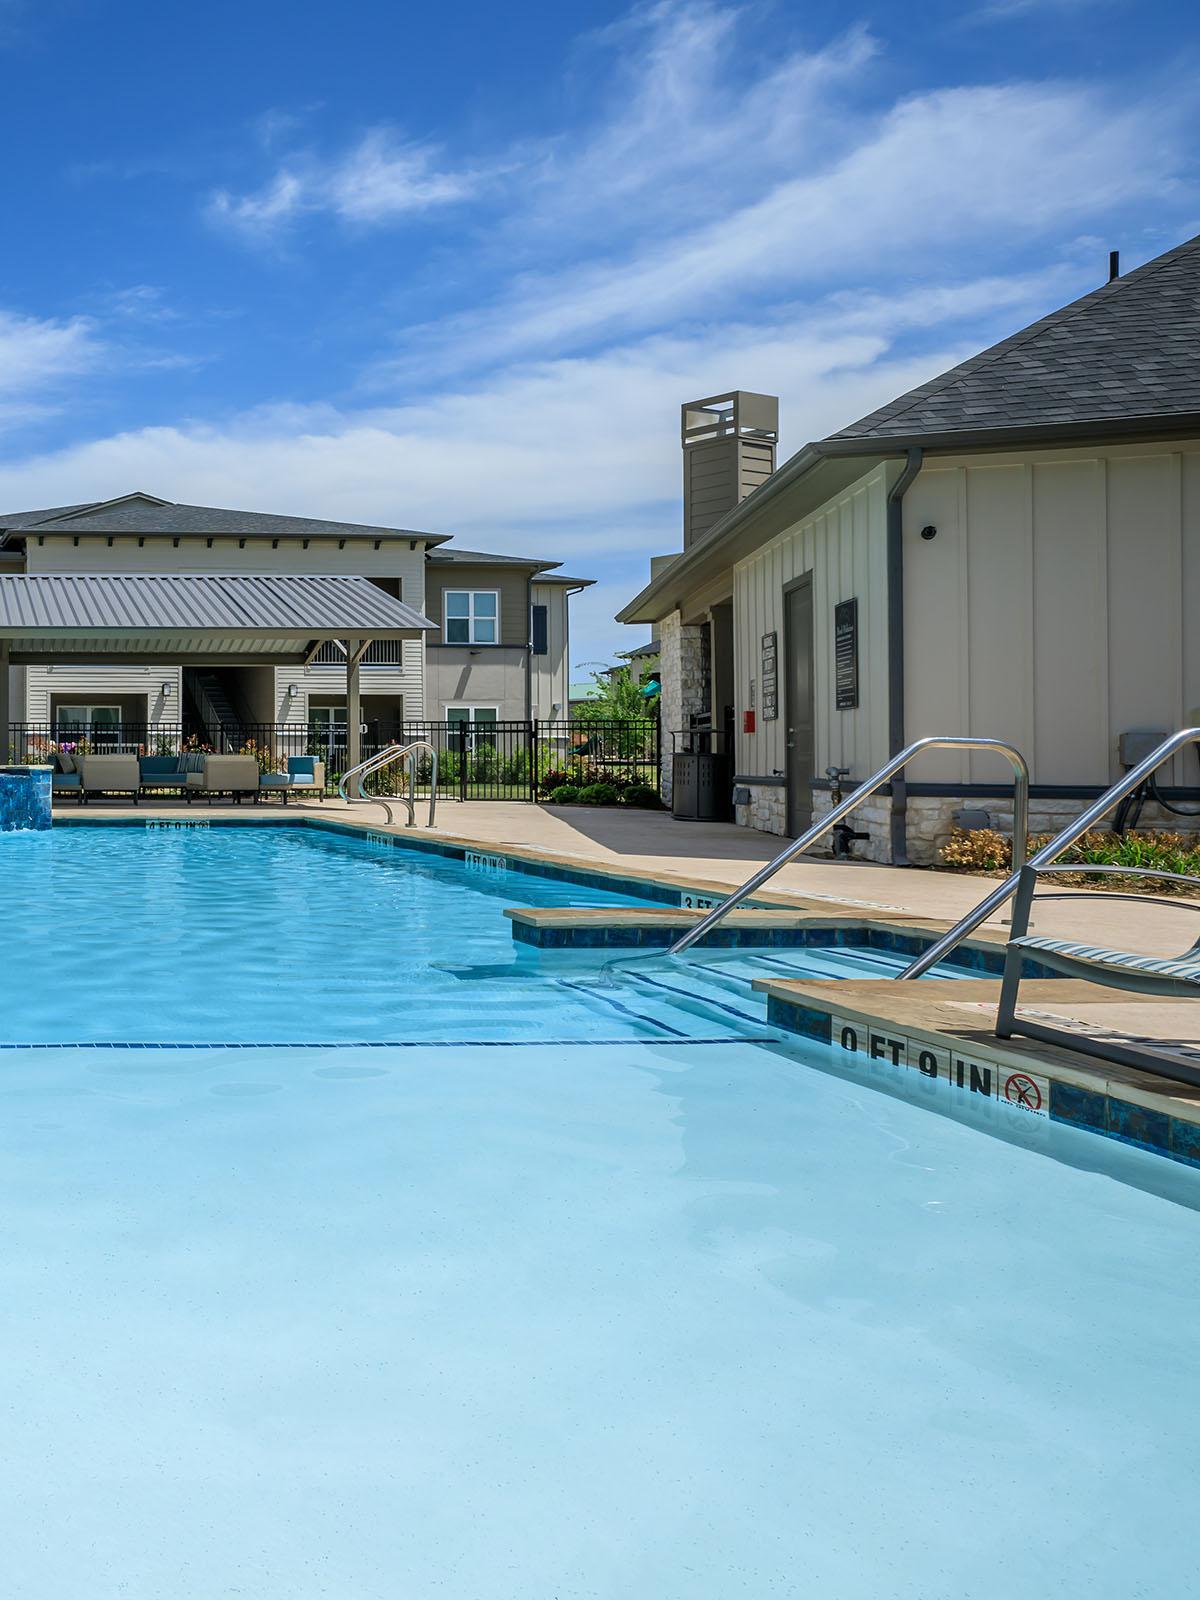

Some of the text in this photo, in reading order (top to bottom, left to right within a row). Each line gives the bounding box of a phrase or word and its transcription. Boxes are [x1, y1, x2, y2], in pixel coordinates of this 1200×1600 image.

[870, 1034, 905, 1067] FT
[918, 1050, 938, 1079] 9
[956, 1059, 992, 1097] IN
